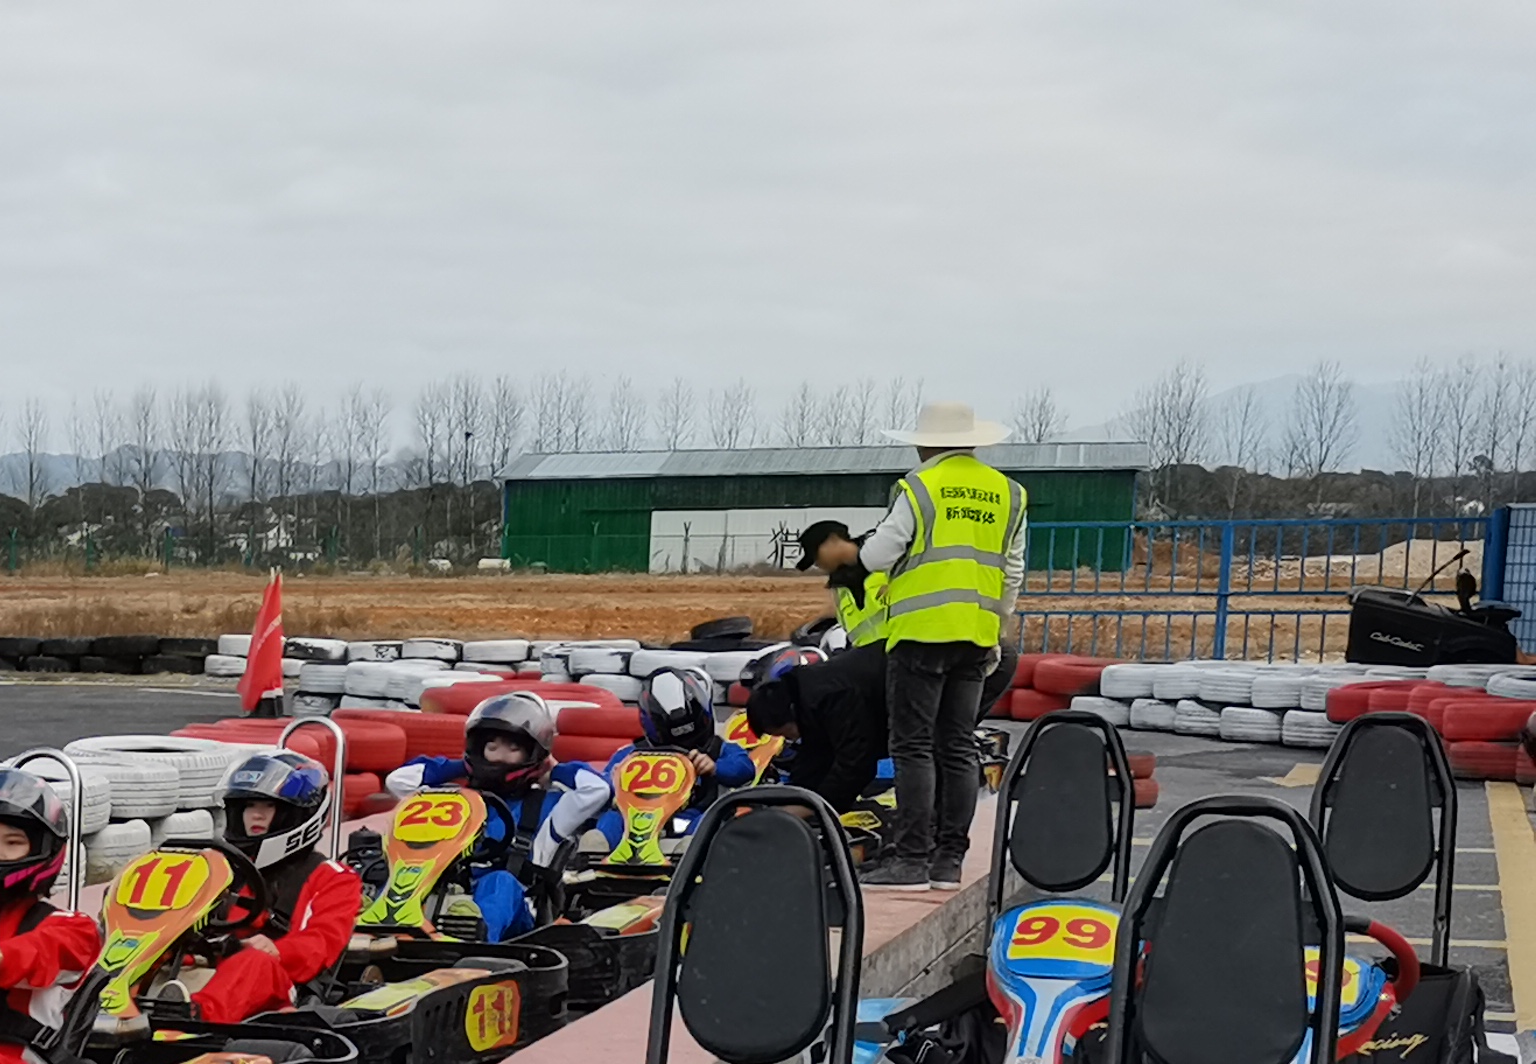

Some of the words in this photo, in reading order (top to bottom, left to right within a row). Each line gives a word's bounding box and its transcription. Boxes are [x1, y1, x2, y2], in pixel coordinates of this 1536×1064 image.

[626, 759, 678, 792] 26
[399, 801, 463, 827] 23
[130, 857, 194, 906] 11
[1011, 916, 1112, 949] 99
[473, 990, 507, 1040] 11
[1357, 1032, 1430, 1060] acing
